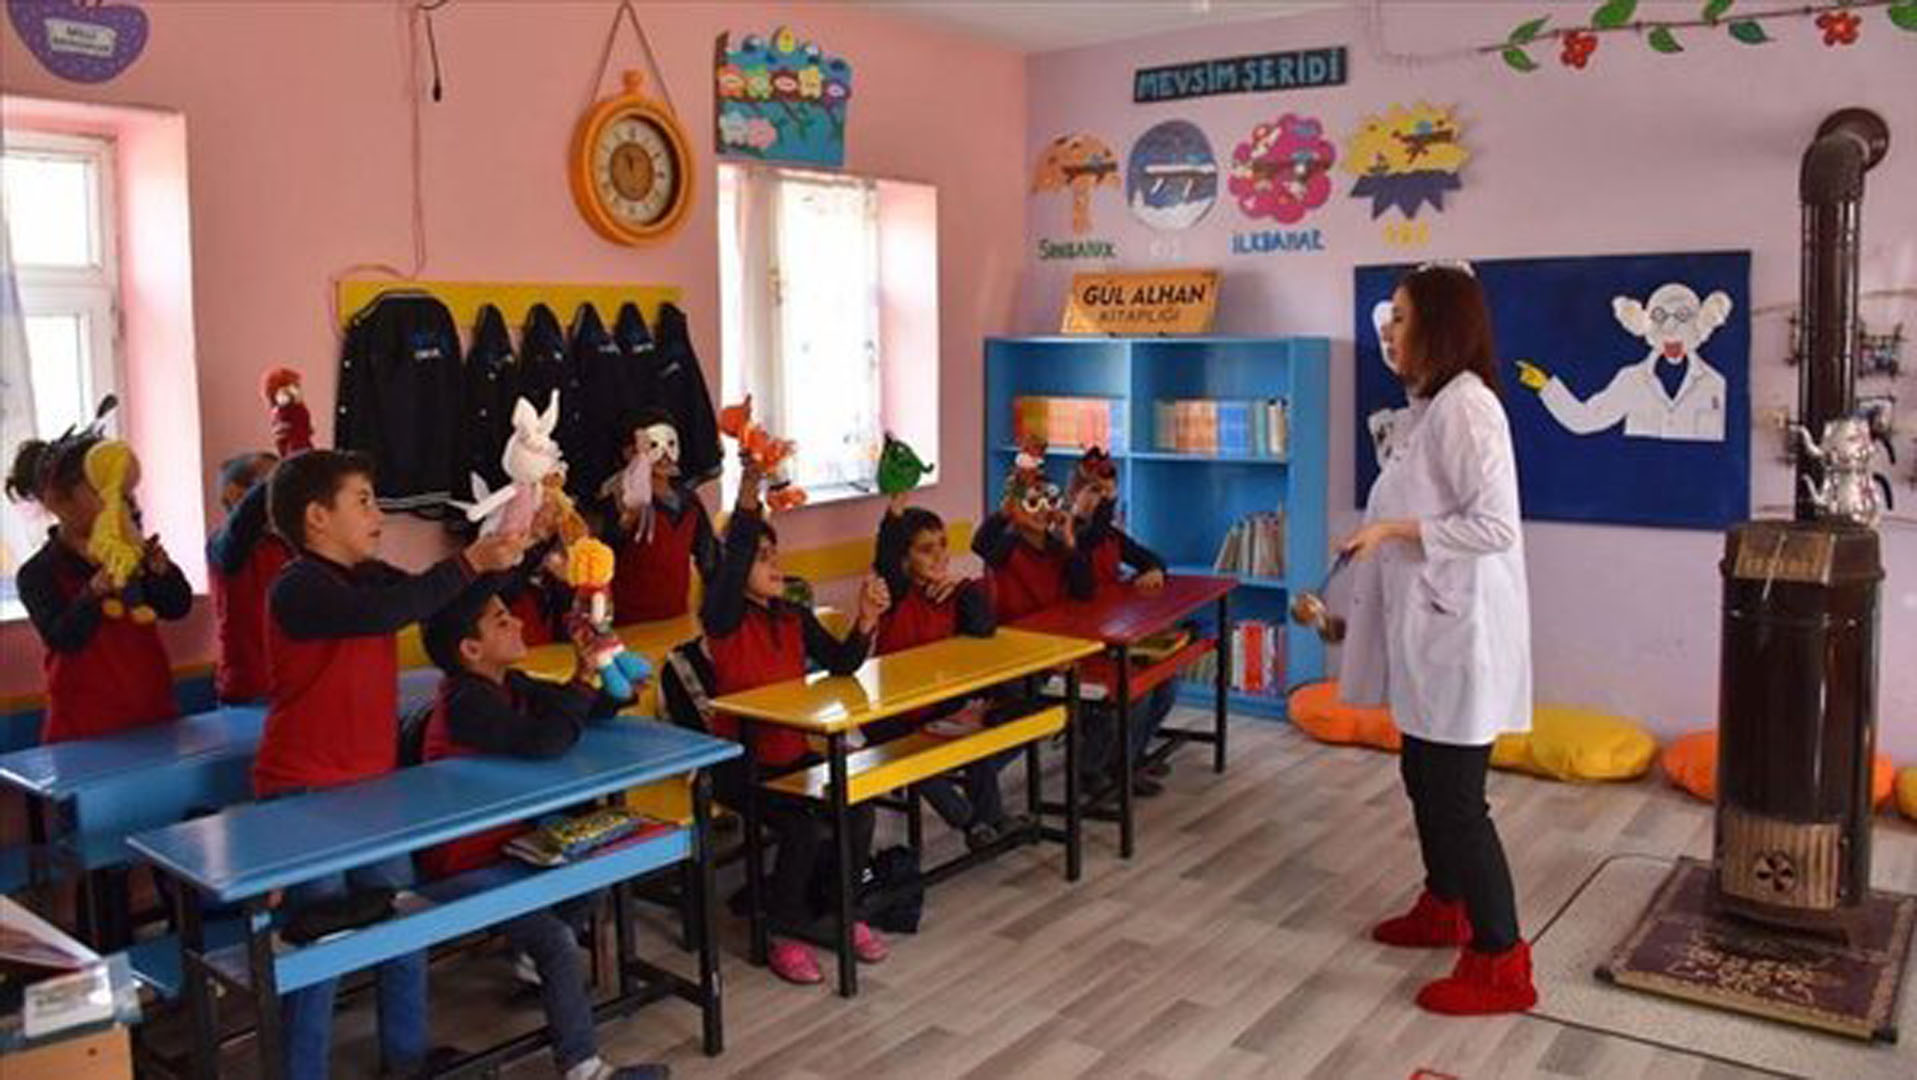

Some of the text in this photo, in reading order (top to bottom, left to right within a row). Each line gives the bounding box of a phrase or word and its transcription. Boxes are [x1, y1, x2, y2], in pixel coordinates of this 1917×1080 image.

[1138, 49, 1340, 98] MEVSİM ŞERİDİ
[1083, 280, 1206, 305] GÜL ALHAN
